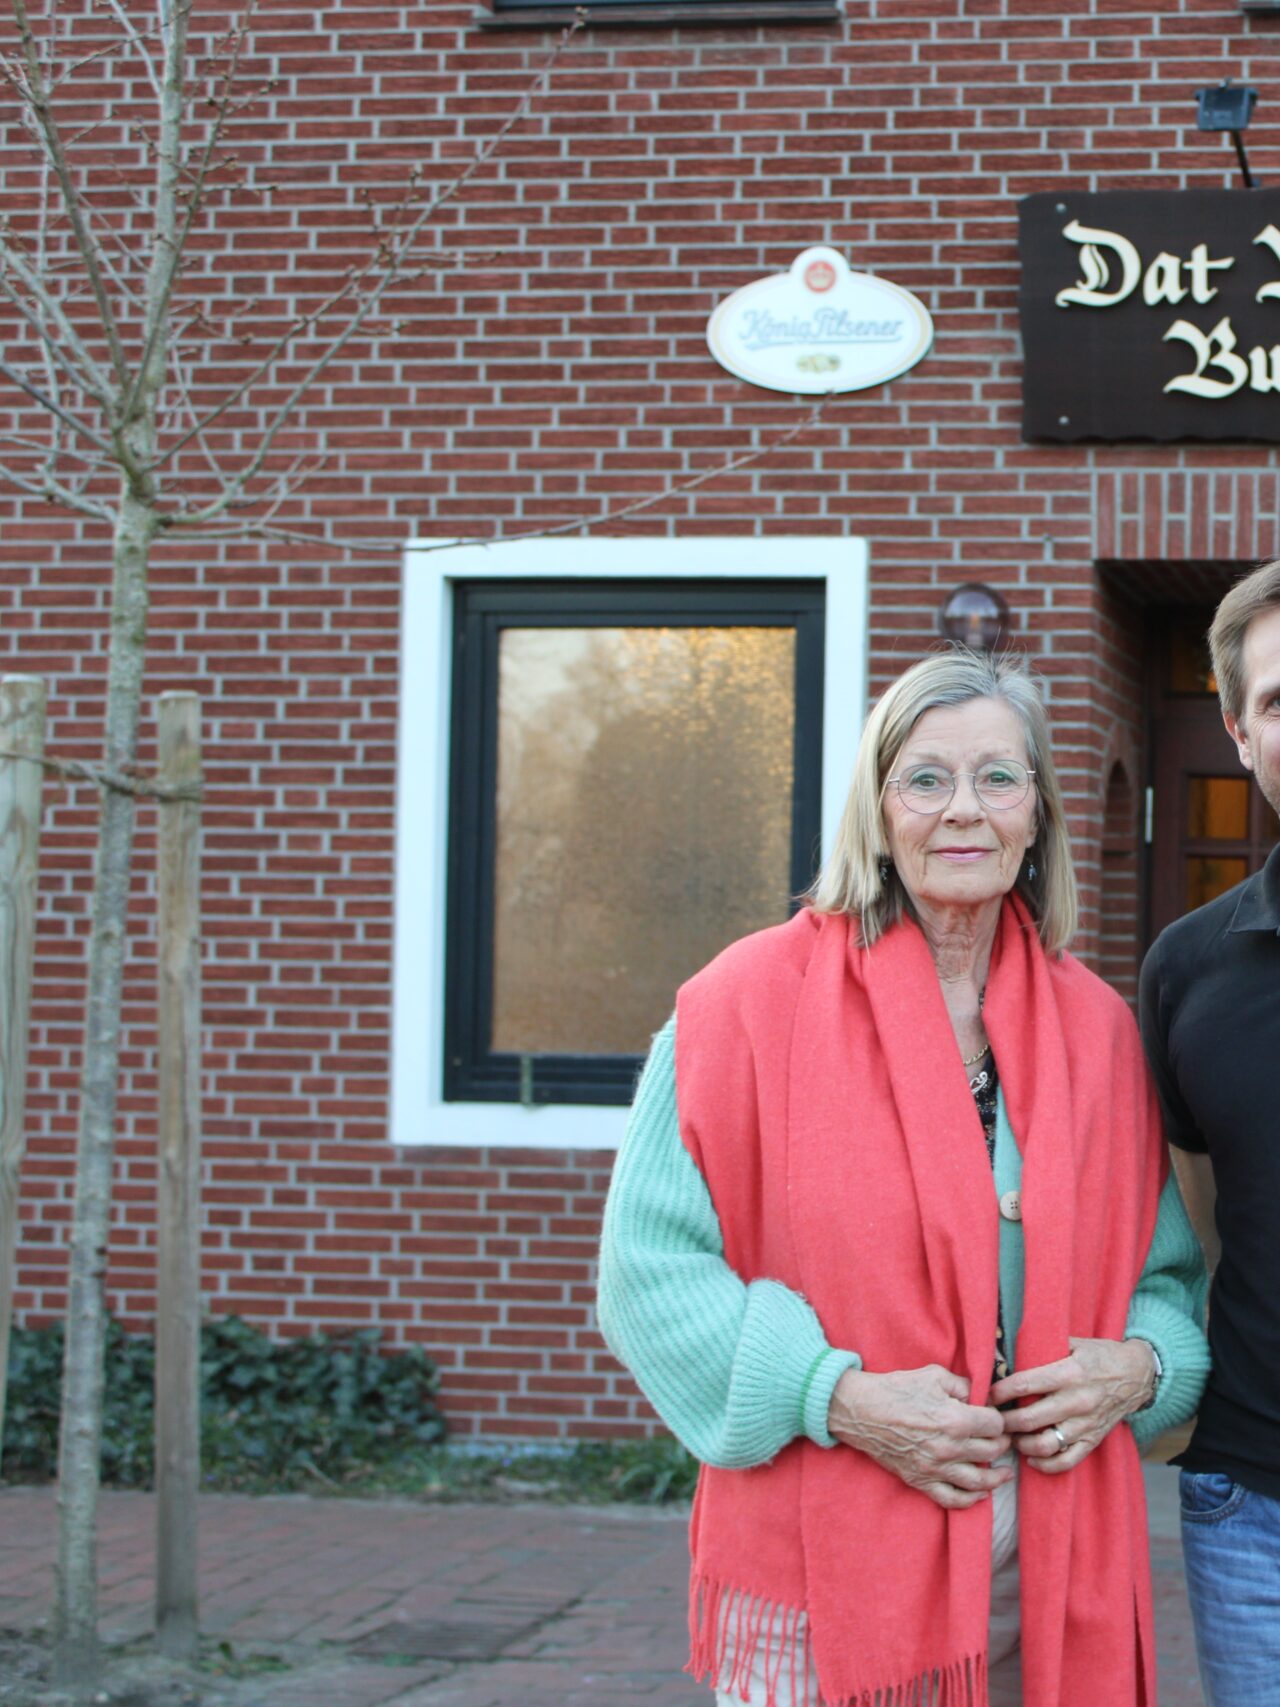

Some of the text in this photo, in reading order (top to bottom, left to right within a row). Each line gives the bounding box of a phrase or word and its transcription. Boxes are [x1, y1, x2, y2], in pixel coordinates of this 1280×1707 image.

[1056, 220, 1234, 307] Dat
[738, 306, 905, 343] König Pilsener
